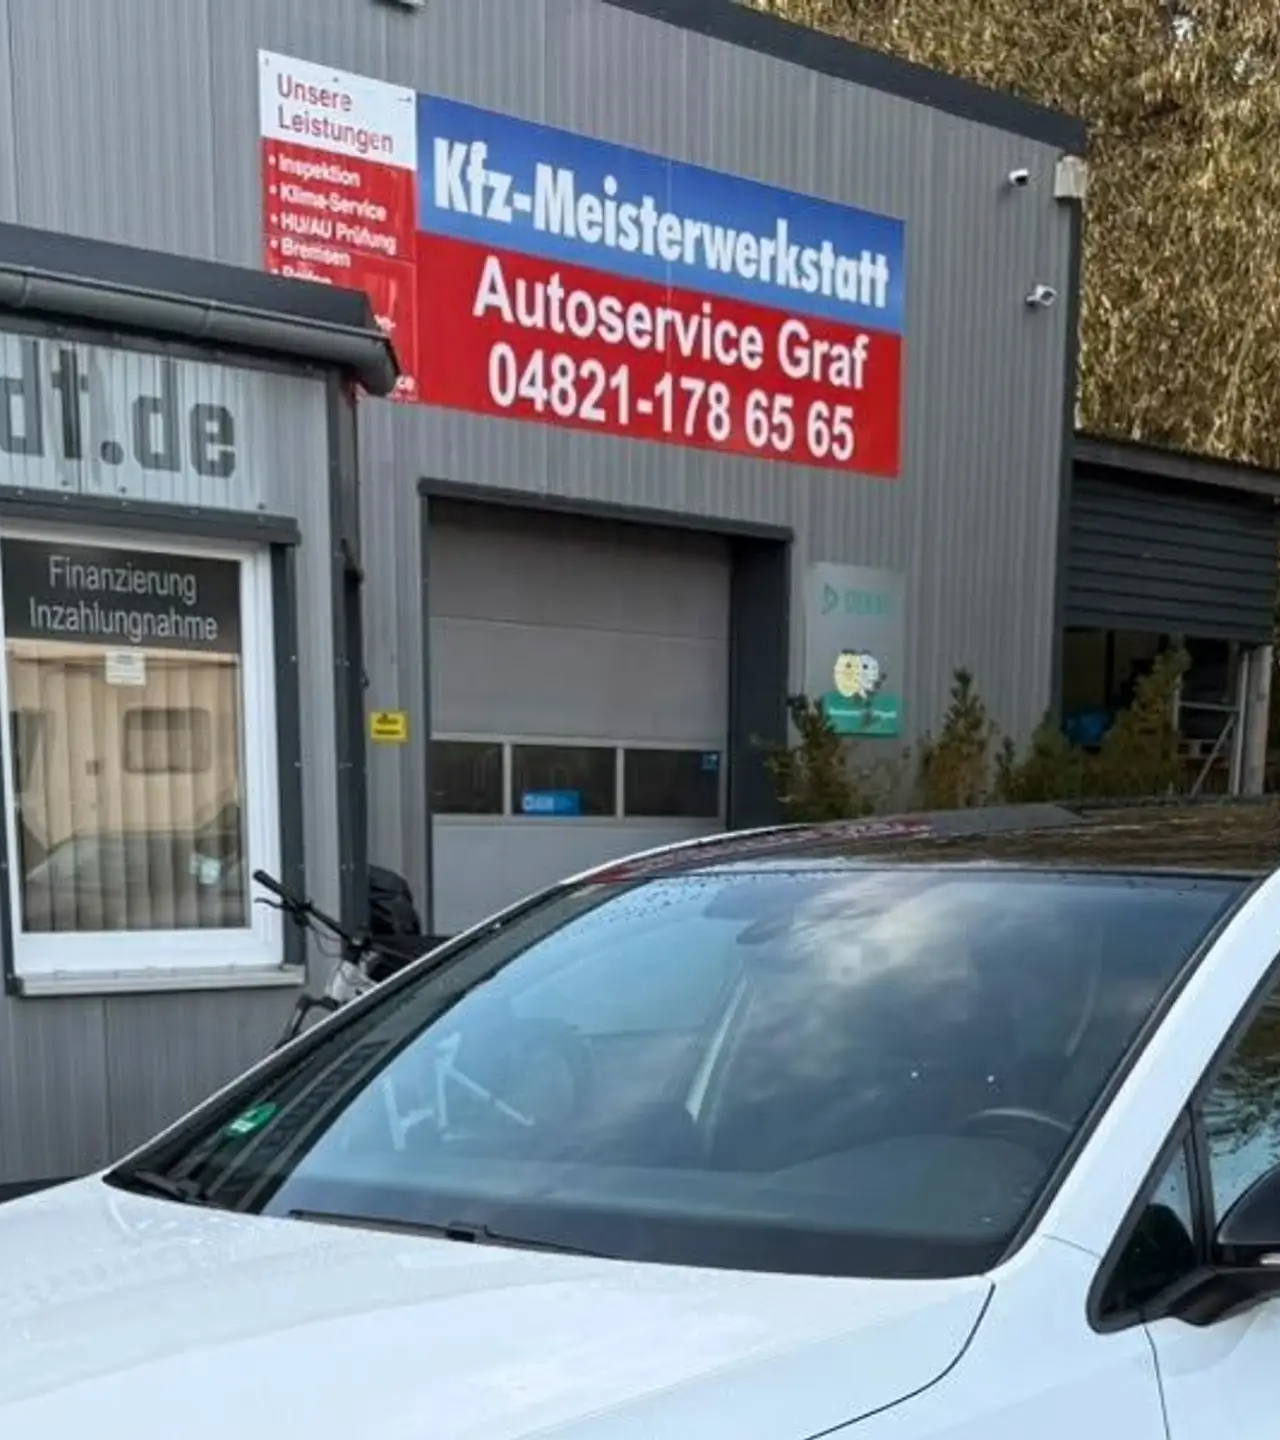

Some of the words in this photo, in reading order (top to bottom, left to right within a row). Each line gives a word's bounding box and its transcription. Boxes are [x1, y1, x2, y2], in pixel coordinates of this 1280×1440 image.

[277, 72, 352, 112] Unsere
[277, 104, 394, 154] Leistungen
[278, 153, 361, 188] Inspektion
[433, 136, 889, 309] Kfz-Meisterwerkstatt
[281, 236, 352, 268] Bremsen
[473, 255, 765, 371] Autoservice
[778, 319, 869, 390] Graf
[488, 342, 731, 442] 04821-178
[745, 389, 795, 453] 65
[807, 400, 855, 461] 65
[49, 554, 198, 606] Finanzierung
[30, 596, 219, 643] Inzahlungnahme
